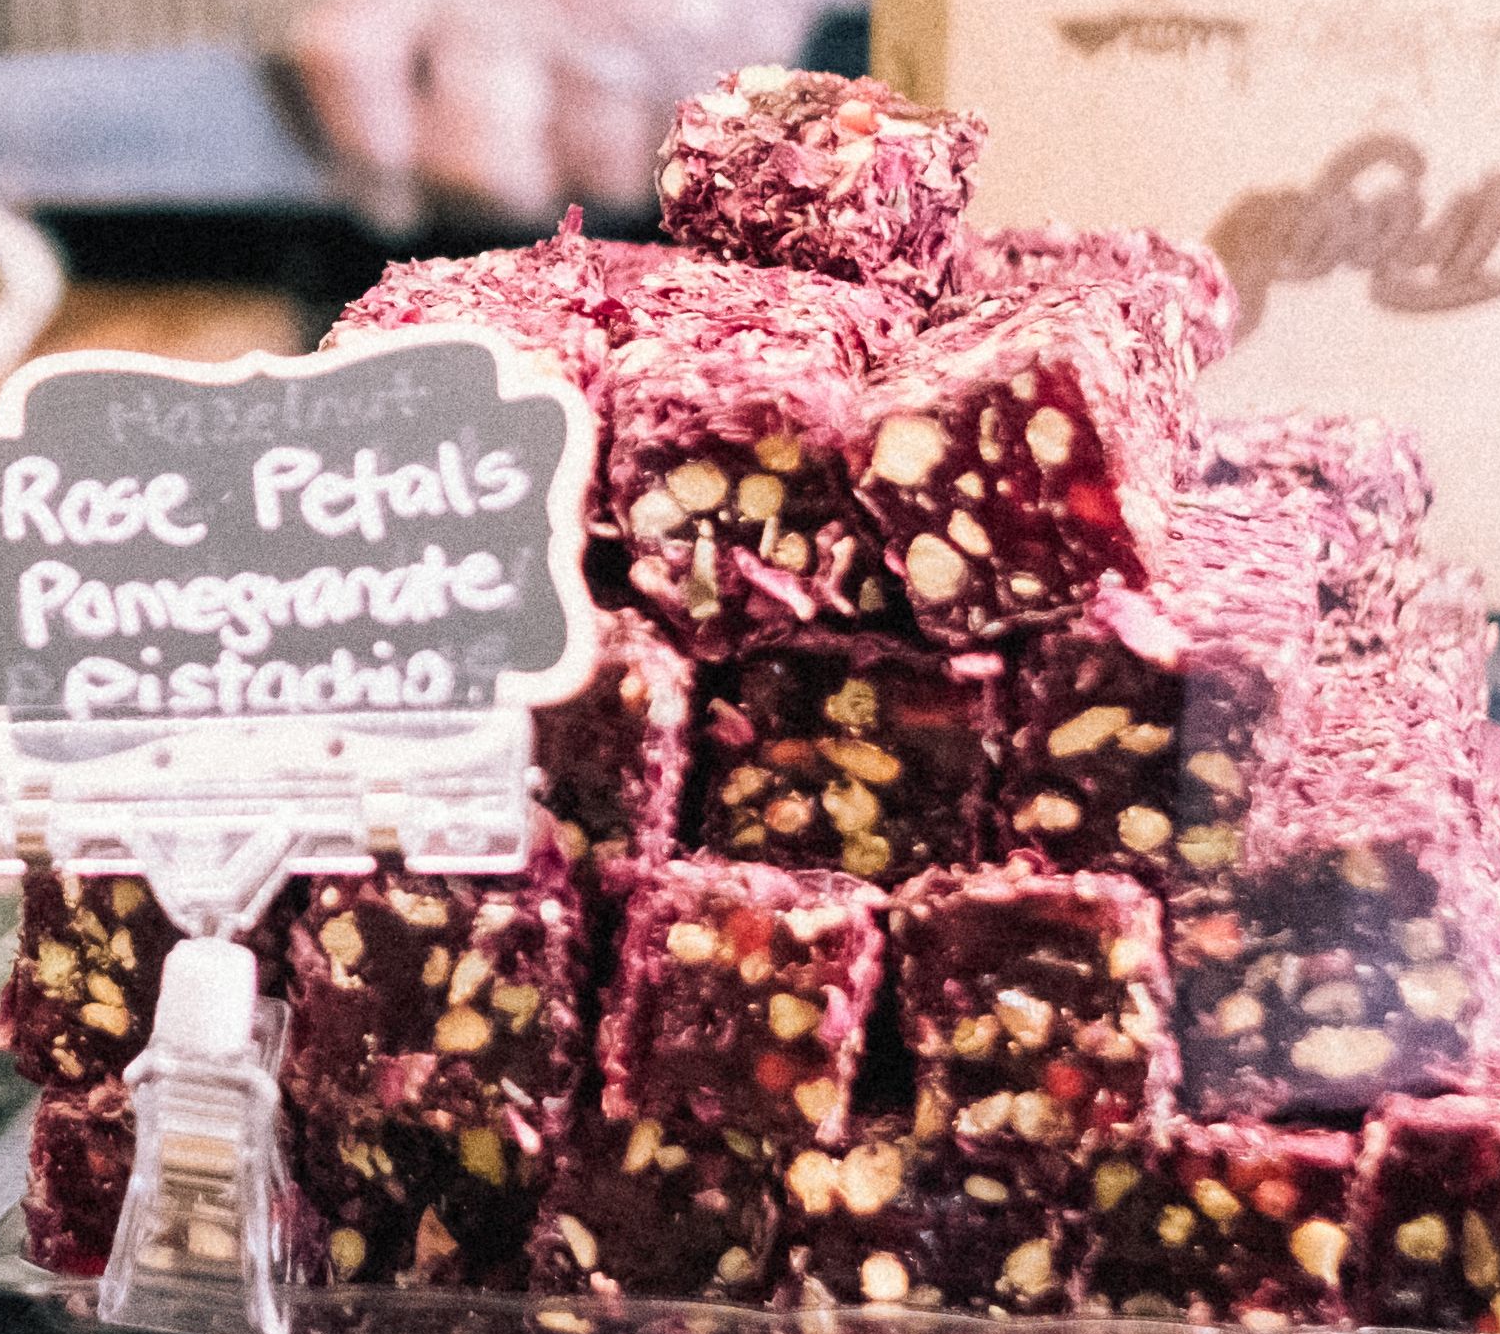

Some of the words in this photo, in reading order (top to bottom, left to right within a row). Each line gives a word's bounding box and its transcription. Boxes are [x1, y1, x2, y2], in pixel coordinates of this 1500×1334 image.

[1, 455, 208, 546] Rose
[252, 440, 532, 543] Petals
[18, 543, 518, 656] Pomegranate
